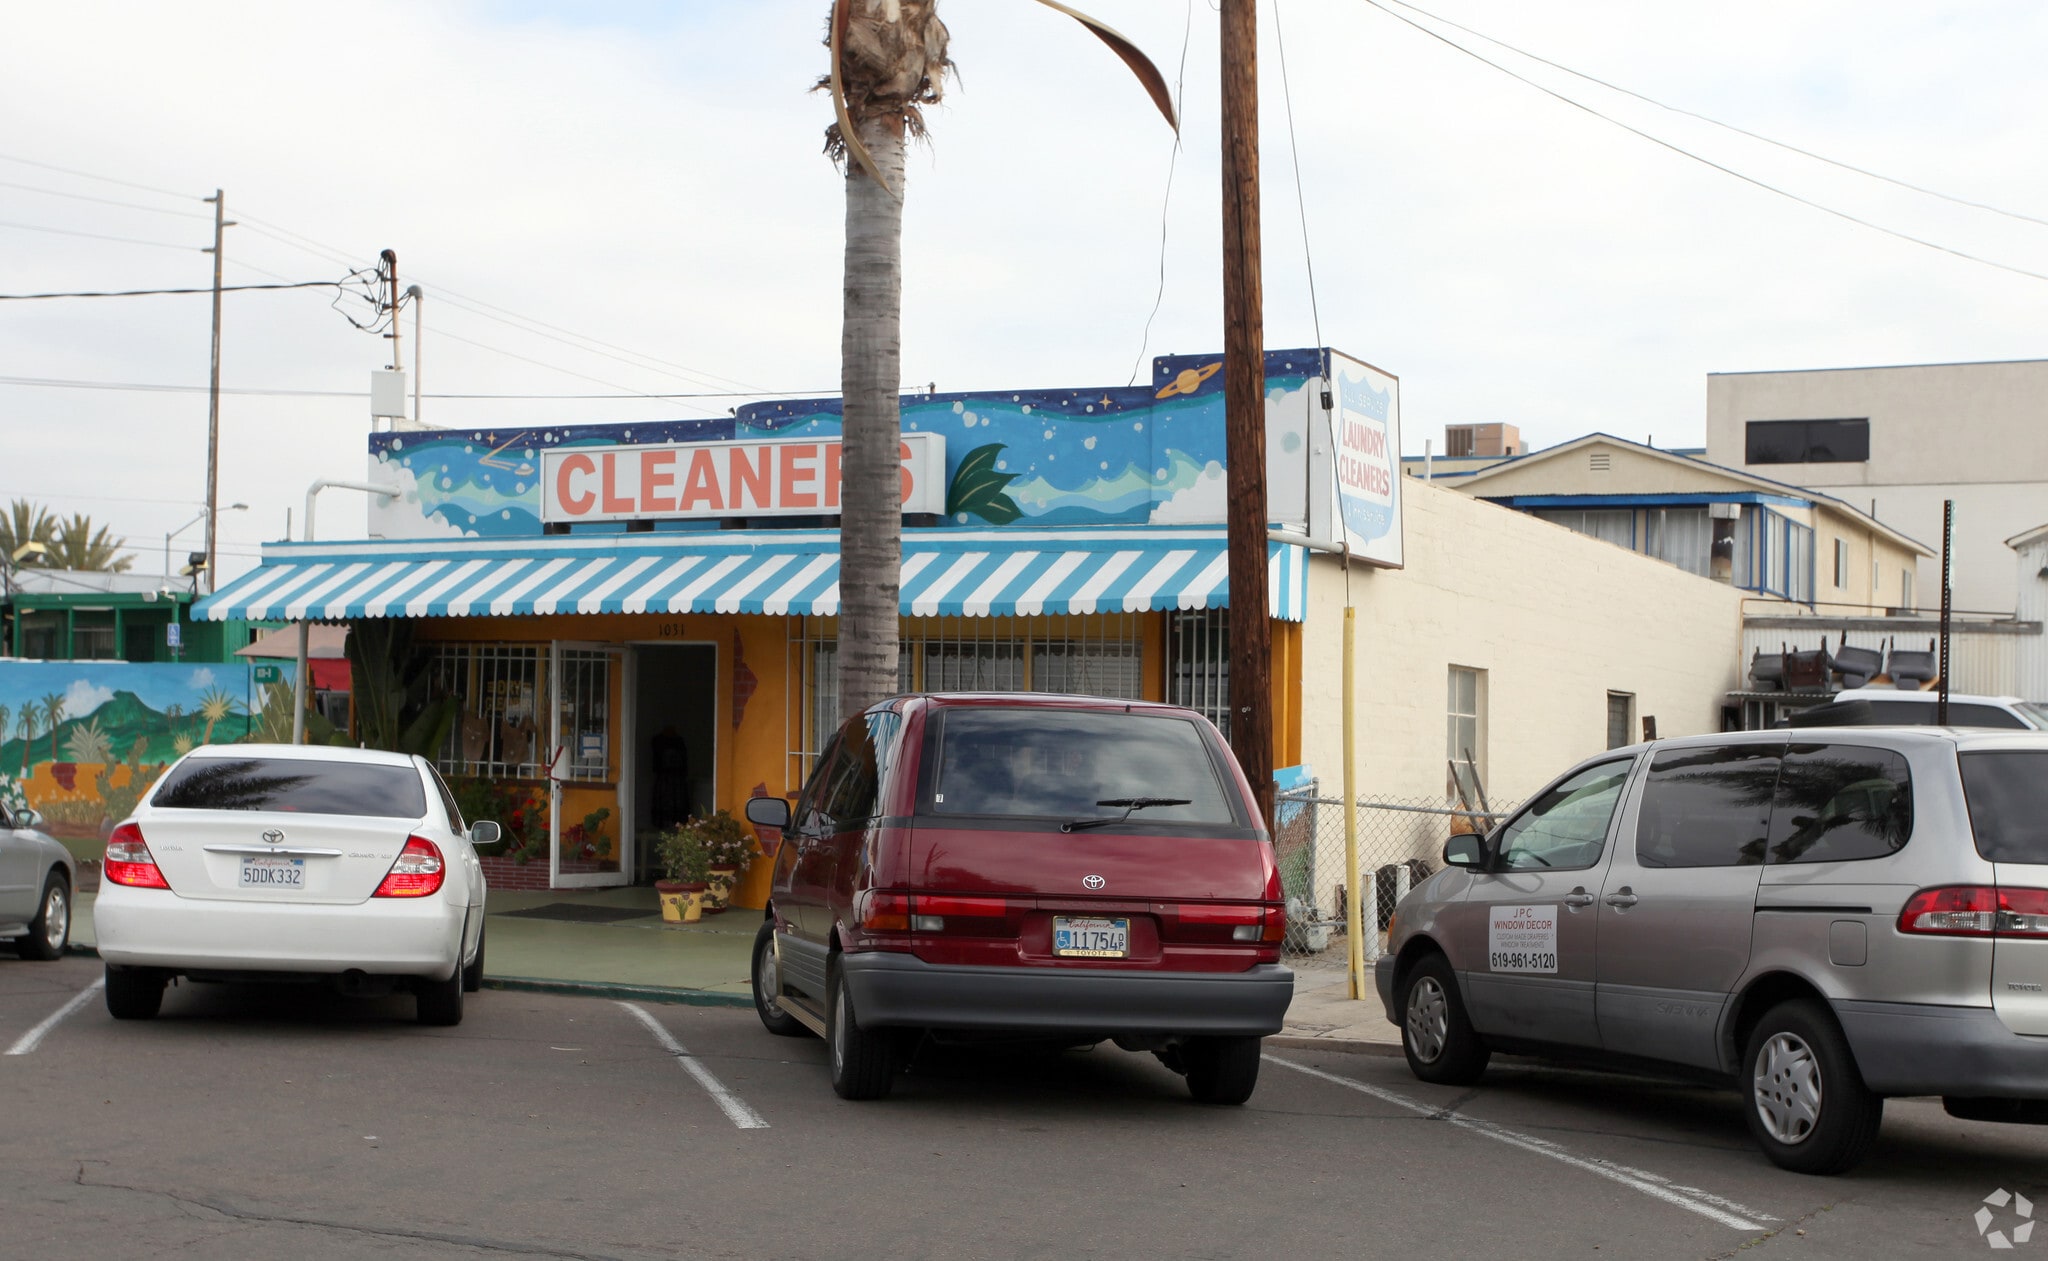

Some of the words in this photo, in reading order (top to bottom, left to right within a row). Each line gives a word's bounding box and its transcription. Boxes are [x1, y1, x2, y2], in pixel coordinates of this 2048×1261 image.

[1343, 418, 1385, 459] LAUNDRY
[1340, 454, 1389, 497] CLEANERS
[659, 624, 684, 637] 1031
[244, 868, 301, 884] 5DDK332
[1069, 919, 1115, 931] California
[1494, 920, 1525, 929] WINDOW
[1526, 920, 1552, 929] DECOR
[1072, 931, 1118, 950] 11754
[1491, 952, 1555, 968] 619-961-5120
